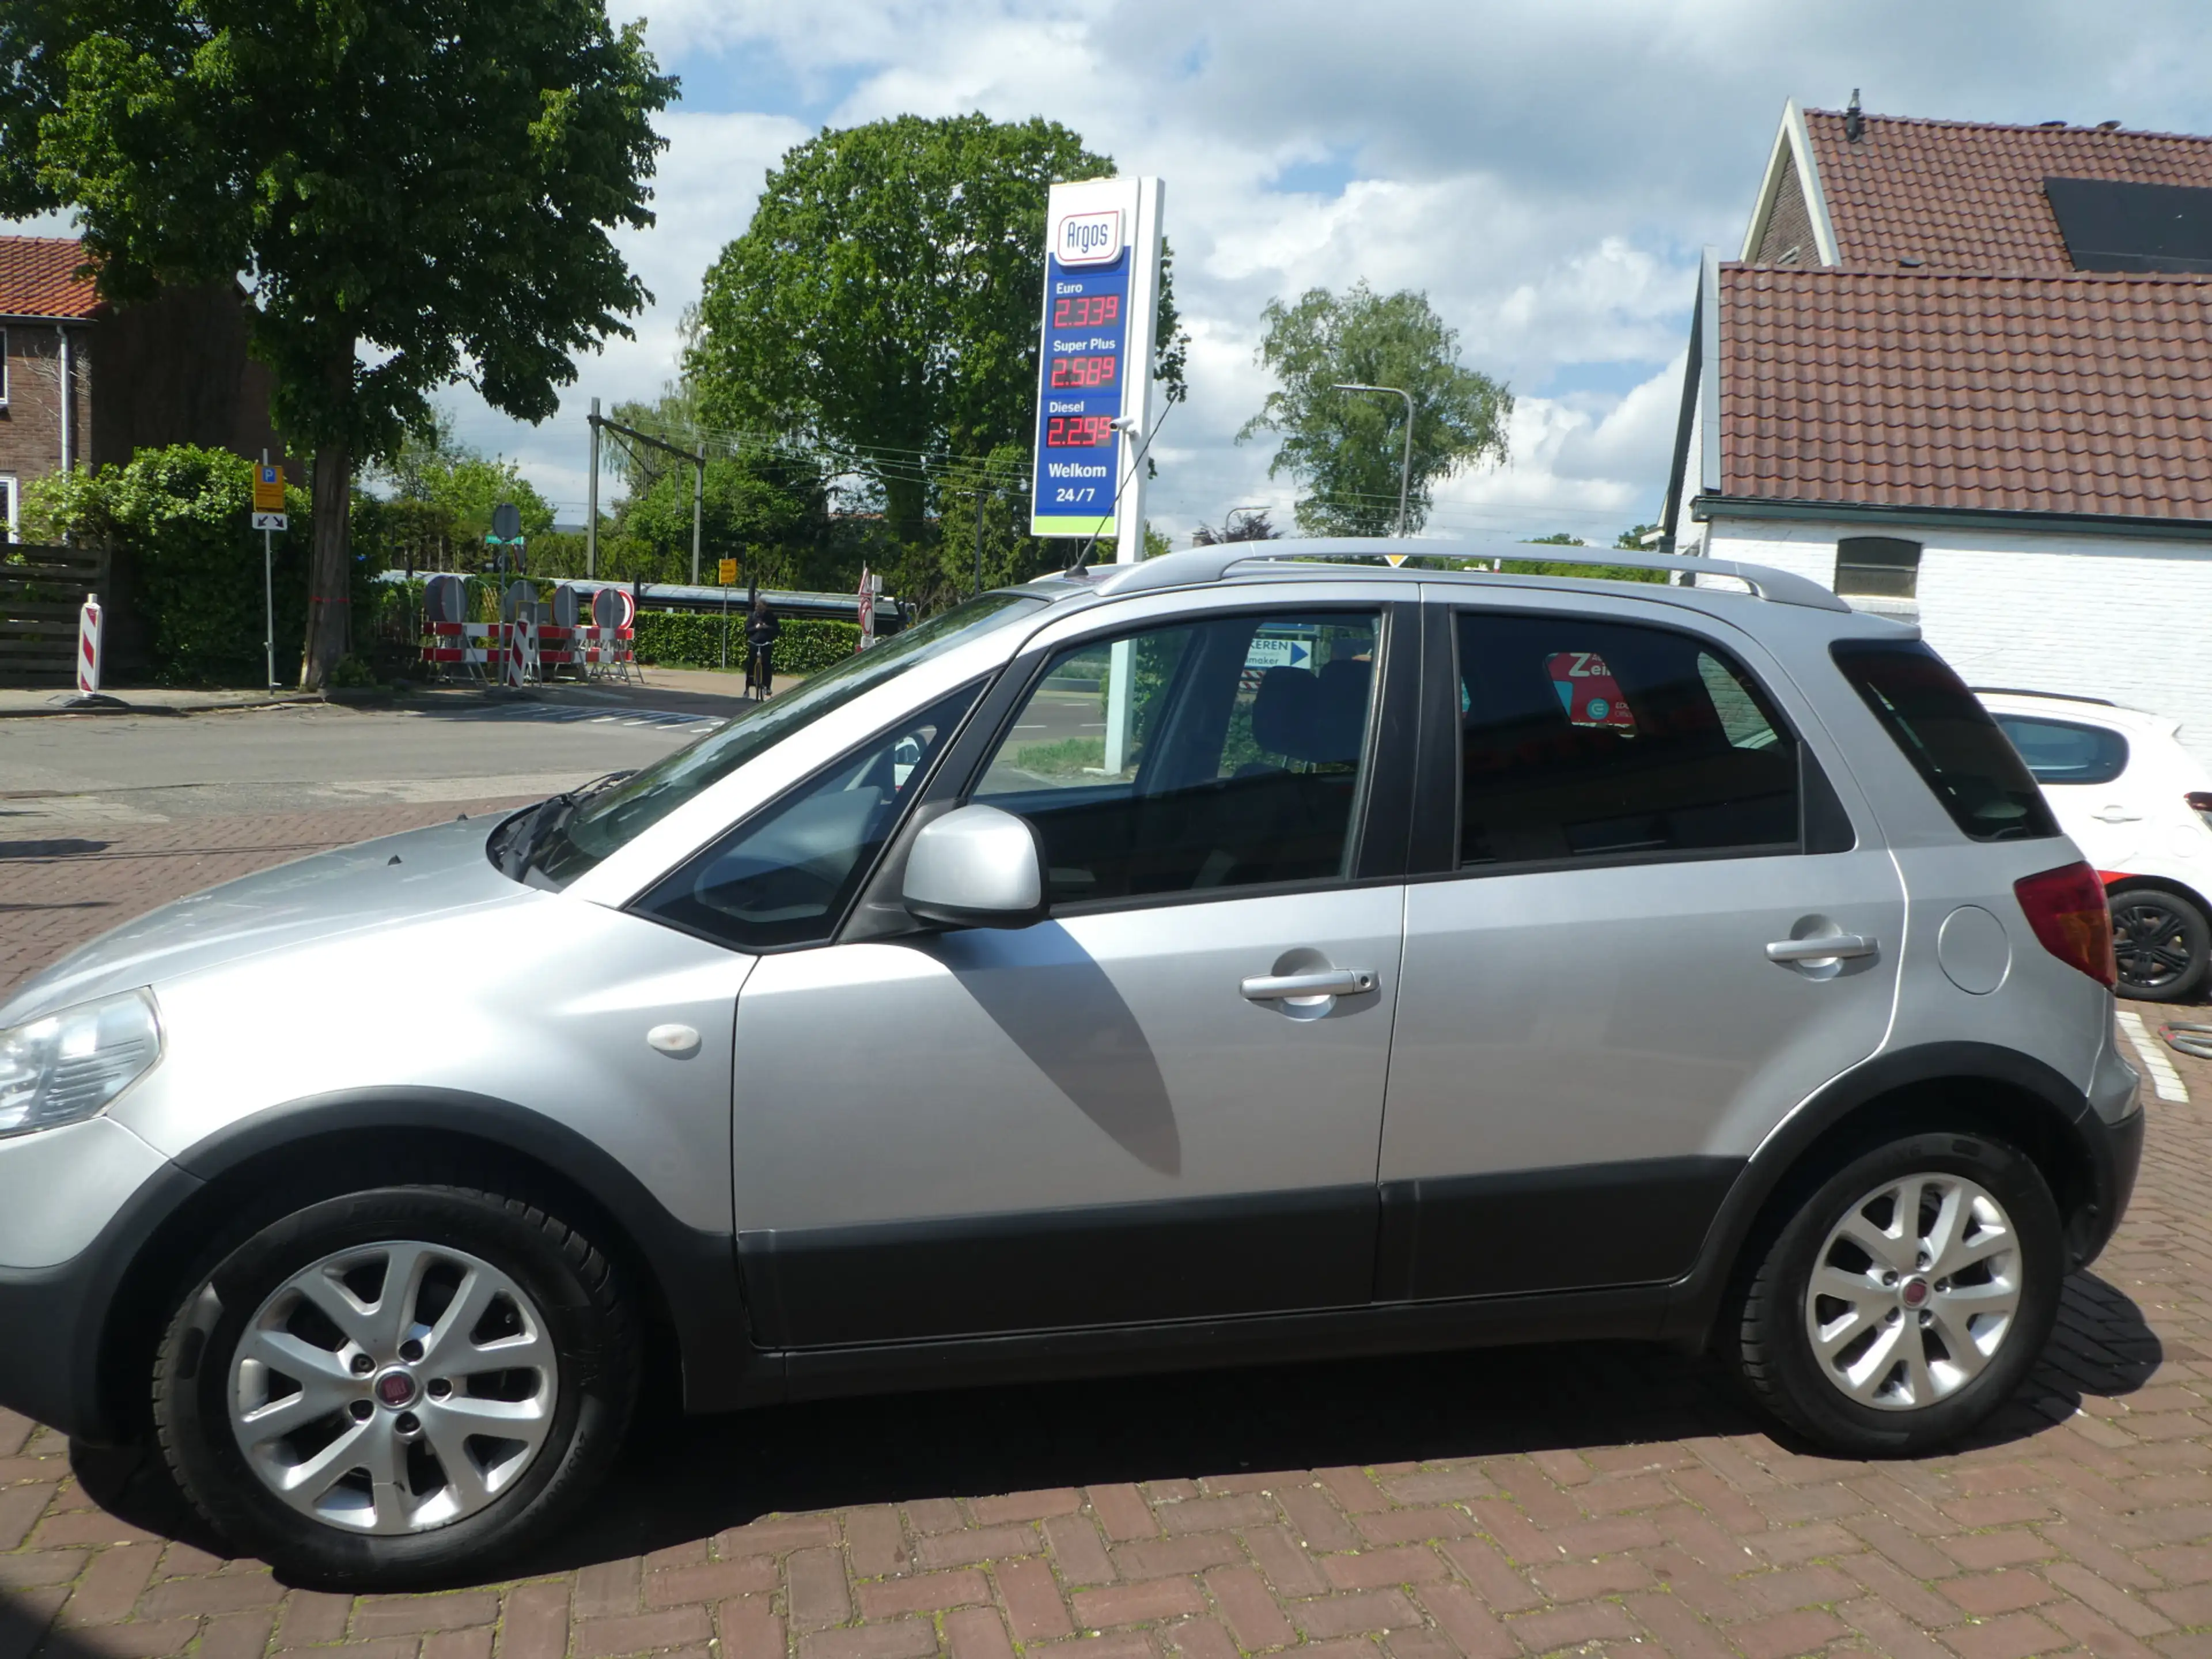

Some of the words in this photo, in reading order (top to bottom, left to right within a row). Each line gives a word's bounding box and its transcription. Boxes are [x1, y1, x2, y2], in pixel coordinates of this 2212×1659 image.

[1067, 221, 1108, 253] Argos
[1056, 282, 1083, 294] Euro
[1054, 296, 1119, 327] 2.339
[1053, 339, 1088, 353] Super
[1090, 338, 1116, 350] Plus
[1051, 356, 1115, 387] 2.589
[1049, 401, 1084, 412] Diesel
[1048, 463, 1107, 478] Welkom
[1056, 488, 1096, 502] 24/7
